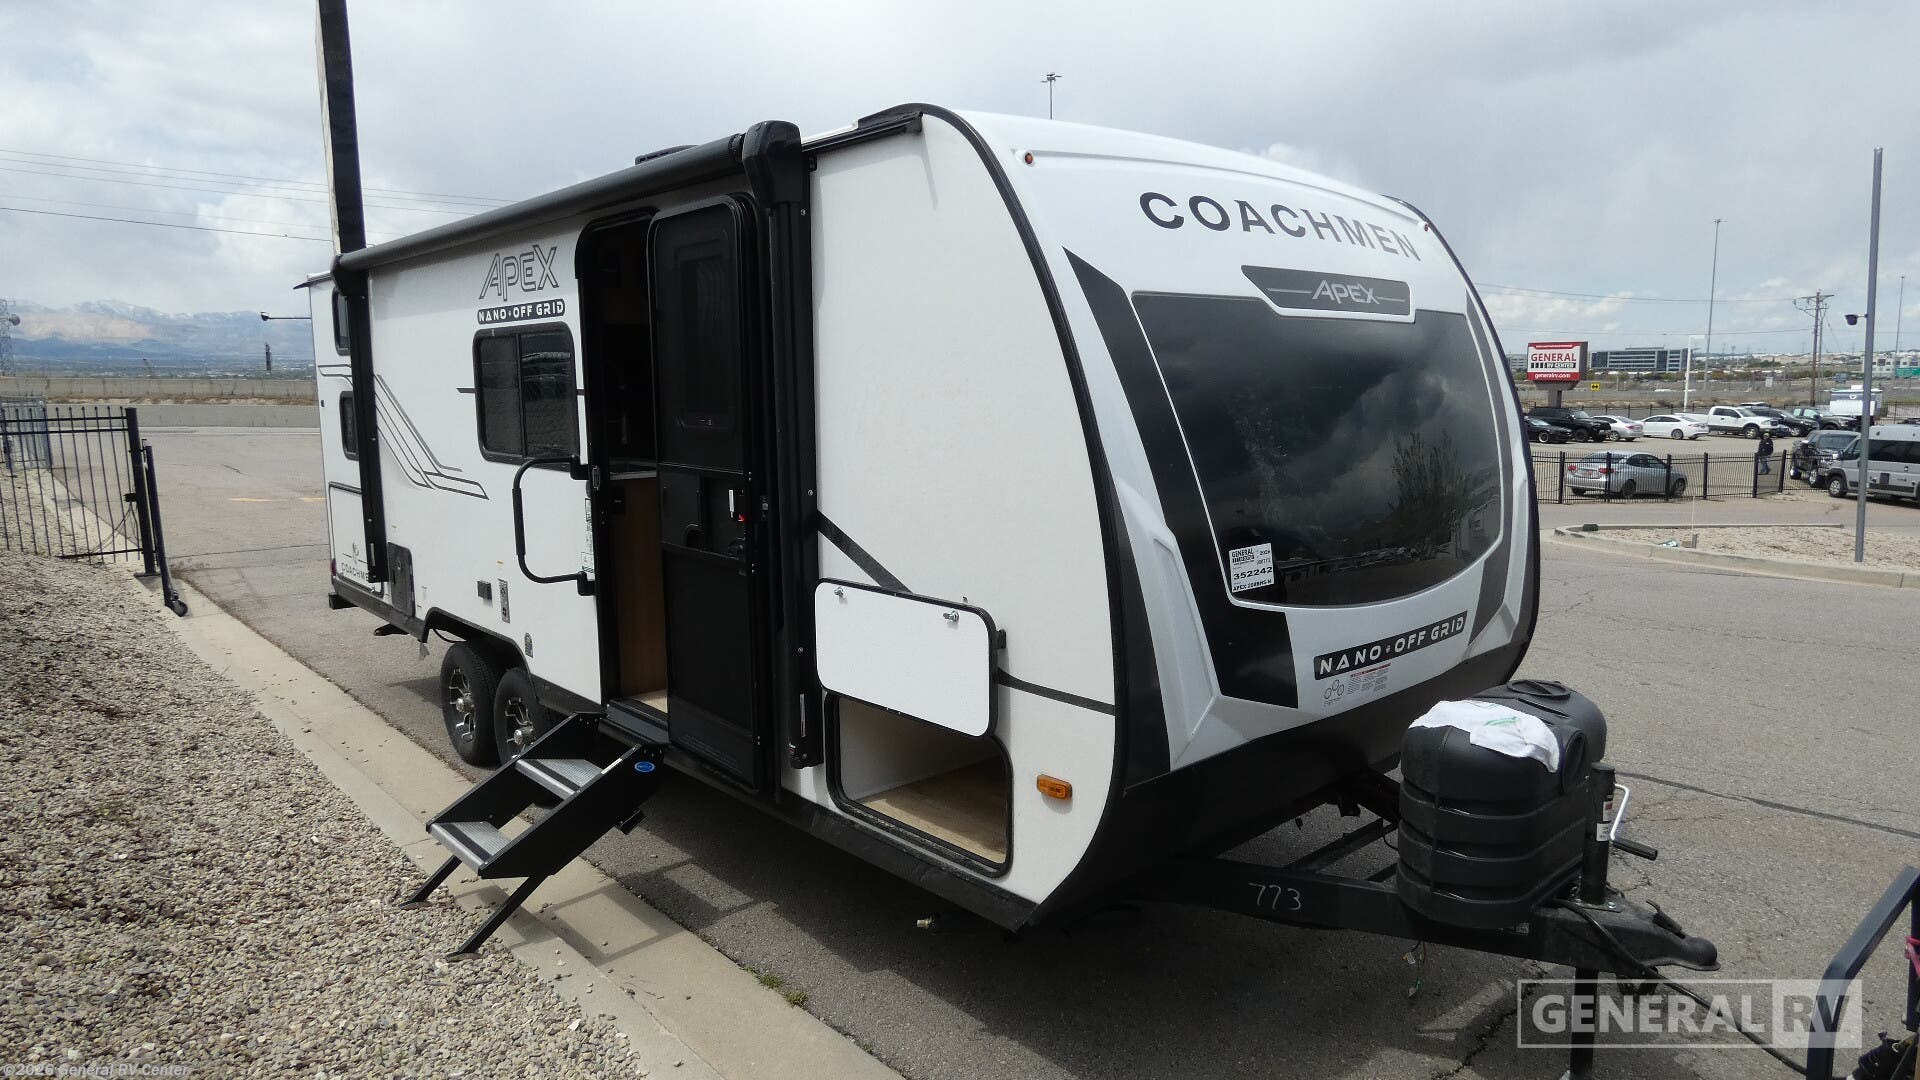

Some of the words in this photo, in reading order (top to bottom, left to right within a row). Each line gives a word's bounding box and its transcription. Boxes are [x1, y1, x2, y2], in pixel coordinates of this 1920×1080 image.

[1139, 191, 1421, 262] COACHMEN
[479, 244, 559, 301] APEX
[1312, 279, 1380, 305] APEX
[536, 301, 564, 316] GRID
[1531, 353, 1576, 361] GENERAL
[1232, 548, 1253, 557] GENERAL
[1233, 567, 1272, 580] 352242
[1431, 616, 1464, 640] GRID
[1248, 882, 1302, 910] 773
